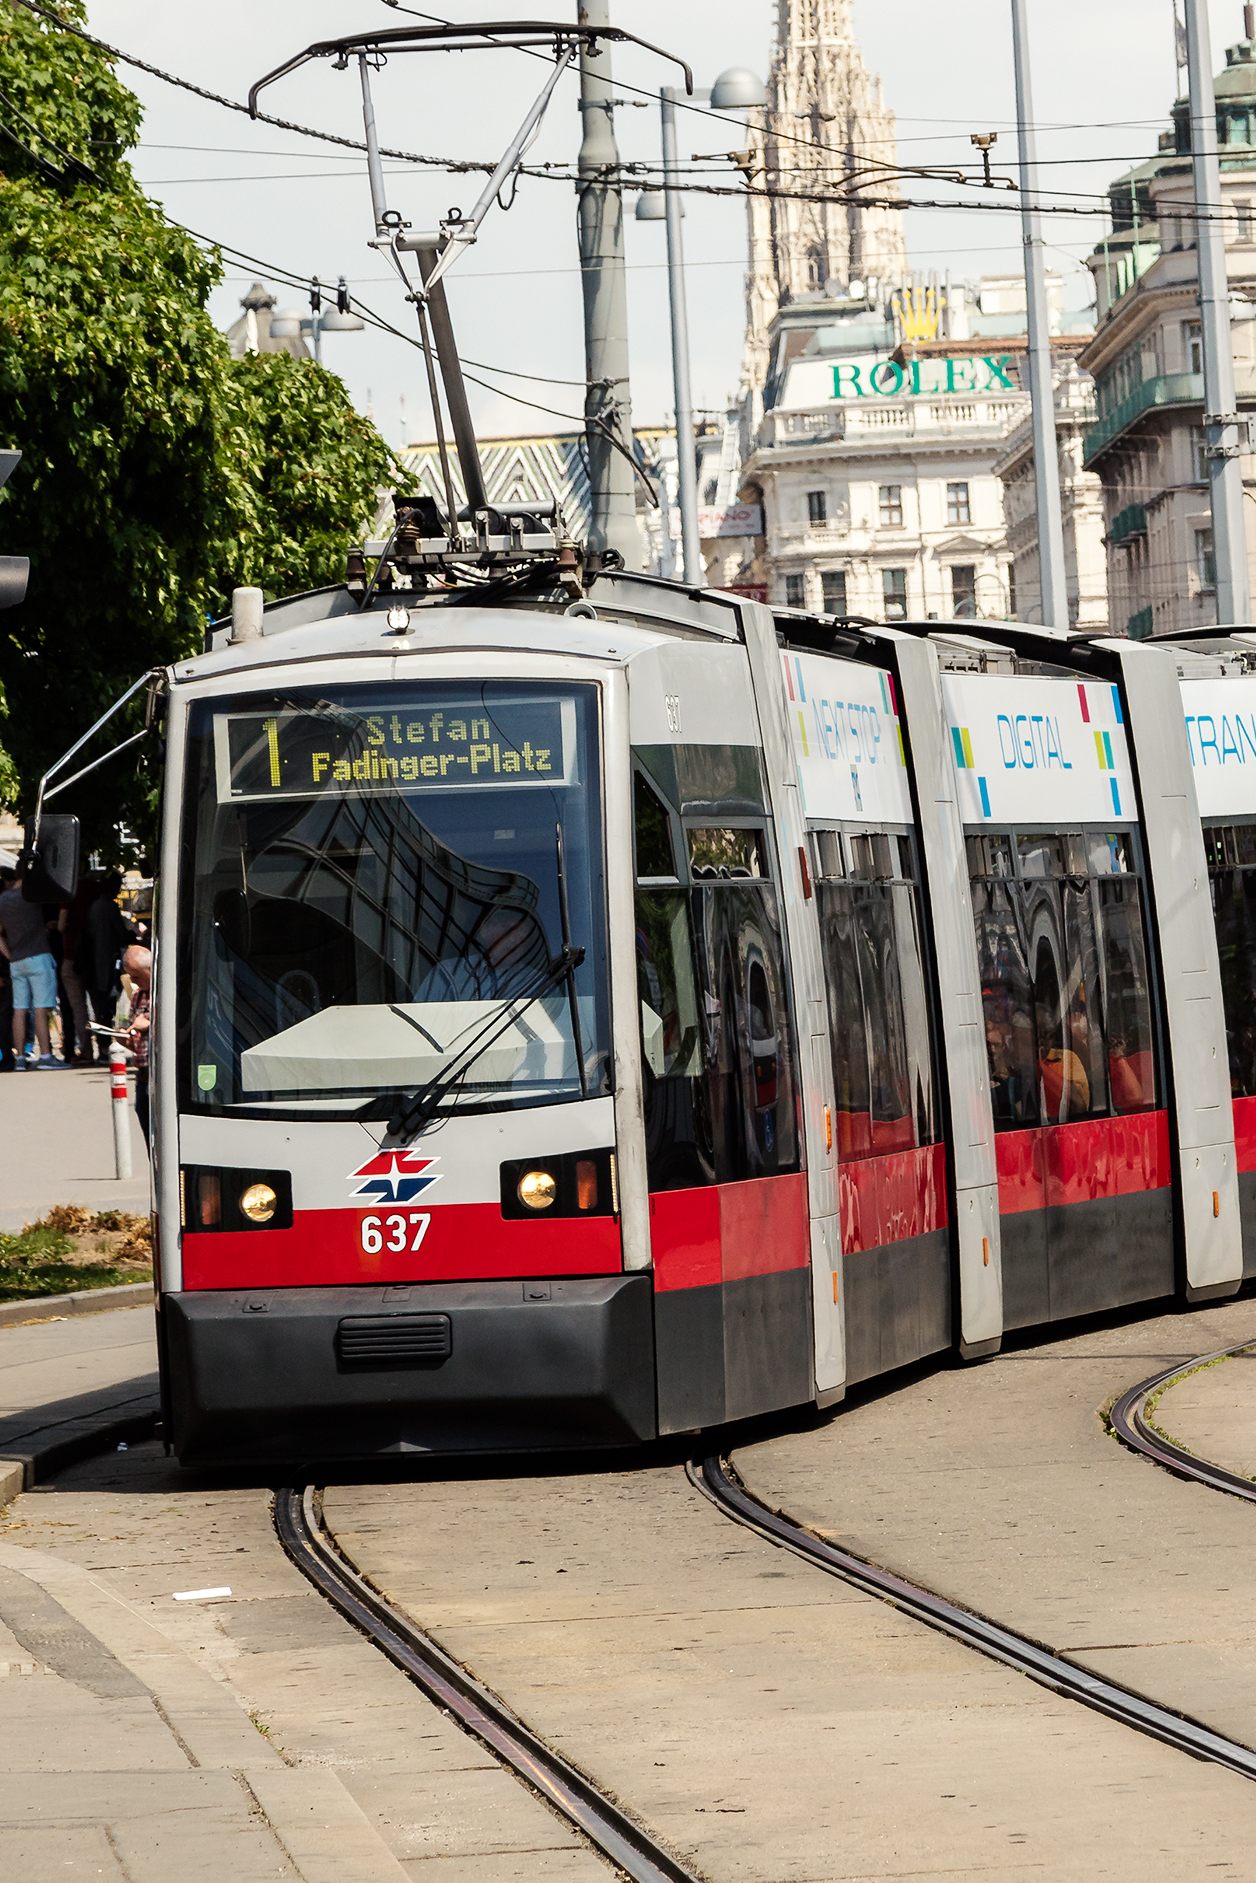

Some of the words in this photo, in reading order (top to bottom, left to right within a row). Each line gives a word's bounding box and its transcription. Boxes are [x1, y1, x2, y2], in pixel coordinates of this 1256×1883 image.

[828, 355, 1016, 400] ROLEX
[366, 713, 491, 746] Stefan
[812, 697, 848, 761] NEXT
[997, 714, 1072, 769] DIGITAL
[262, 717, 281, 787] 1
[311, 741, 553, 783] Fadinger-Platz
[361, 1212, 431, 1254] 637
